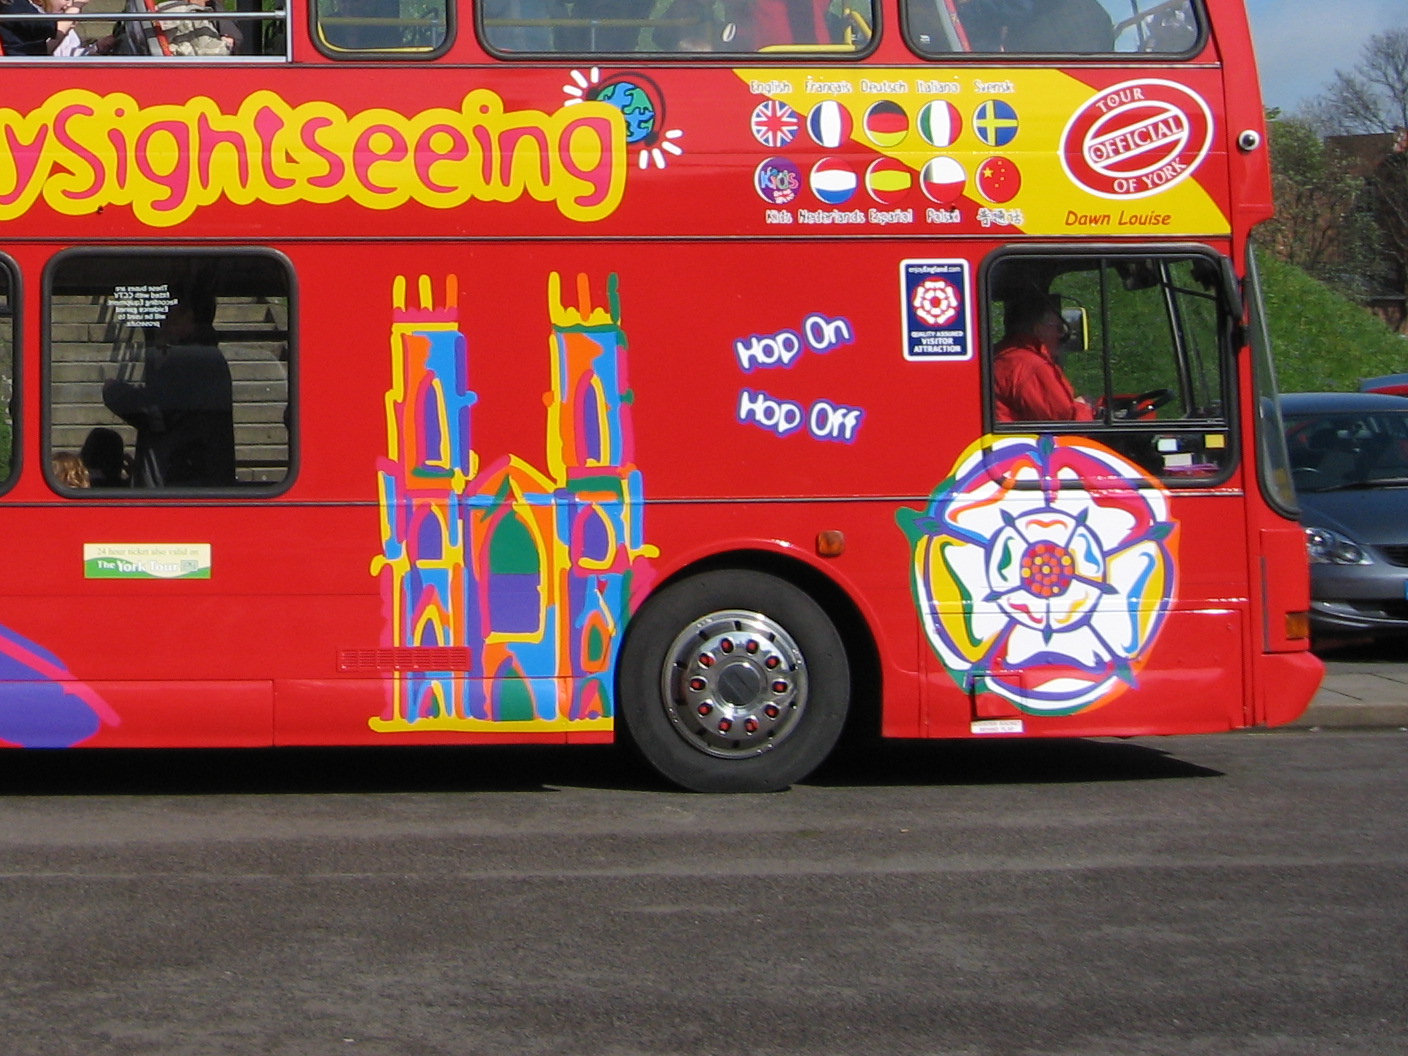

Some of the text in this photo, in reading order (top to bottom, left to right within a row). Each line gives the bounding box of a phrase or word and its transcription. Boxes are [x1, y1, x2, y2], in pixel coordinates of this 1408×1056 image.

[749, 80, 792, 96] English
[804, 80, 853, 96] Français
[859, 78, 908, 94] Deutsch
[916, 79, 960, 94] Italiano
[973, 78, 1015, 94] Svensk
[1095, 87, 1145, 113] TOUR
[1089, 117, 1182, 162] OFFICIAL
[1113, 157, 1188, 193] OF YORK
[765, 209, 793, 224] Kids
[797, 209, 865, 224] Nederlands
[868, 208, 913, 225] Español
[925, 208, 961, 224] Polski
[1064, 210, 1172, 226] Dawn Louise
[803, 315, 851, 350] On
[910, 330, 935, 338] QUALITY
[913, 345, 961, 353] ATTRACTION
[920, 337, 954, 345] VISITOR
[809, 401, 862, 440] Off
[108, 547, 125, 555] hour
[127, 547, 149, 555] ticket
[151, 547, 167, 555] also
[169, 547, 187, 555] valid
[97, 560, 180, 572] The York Tour
